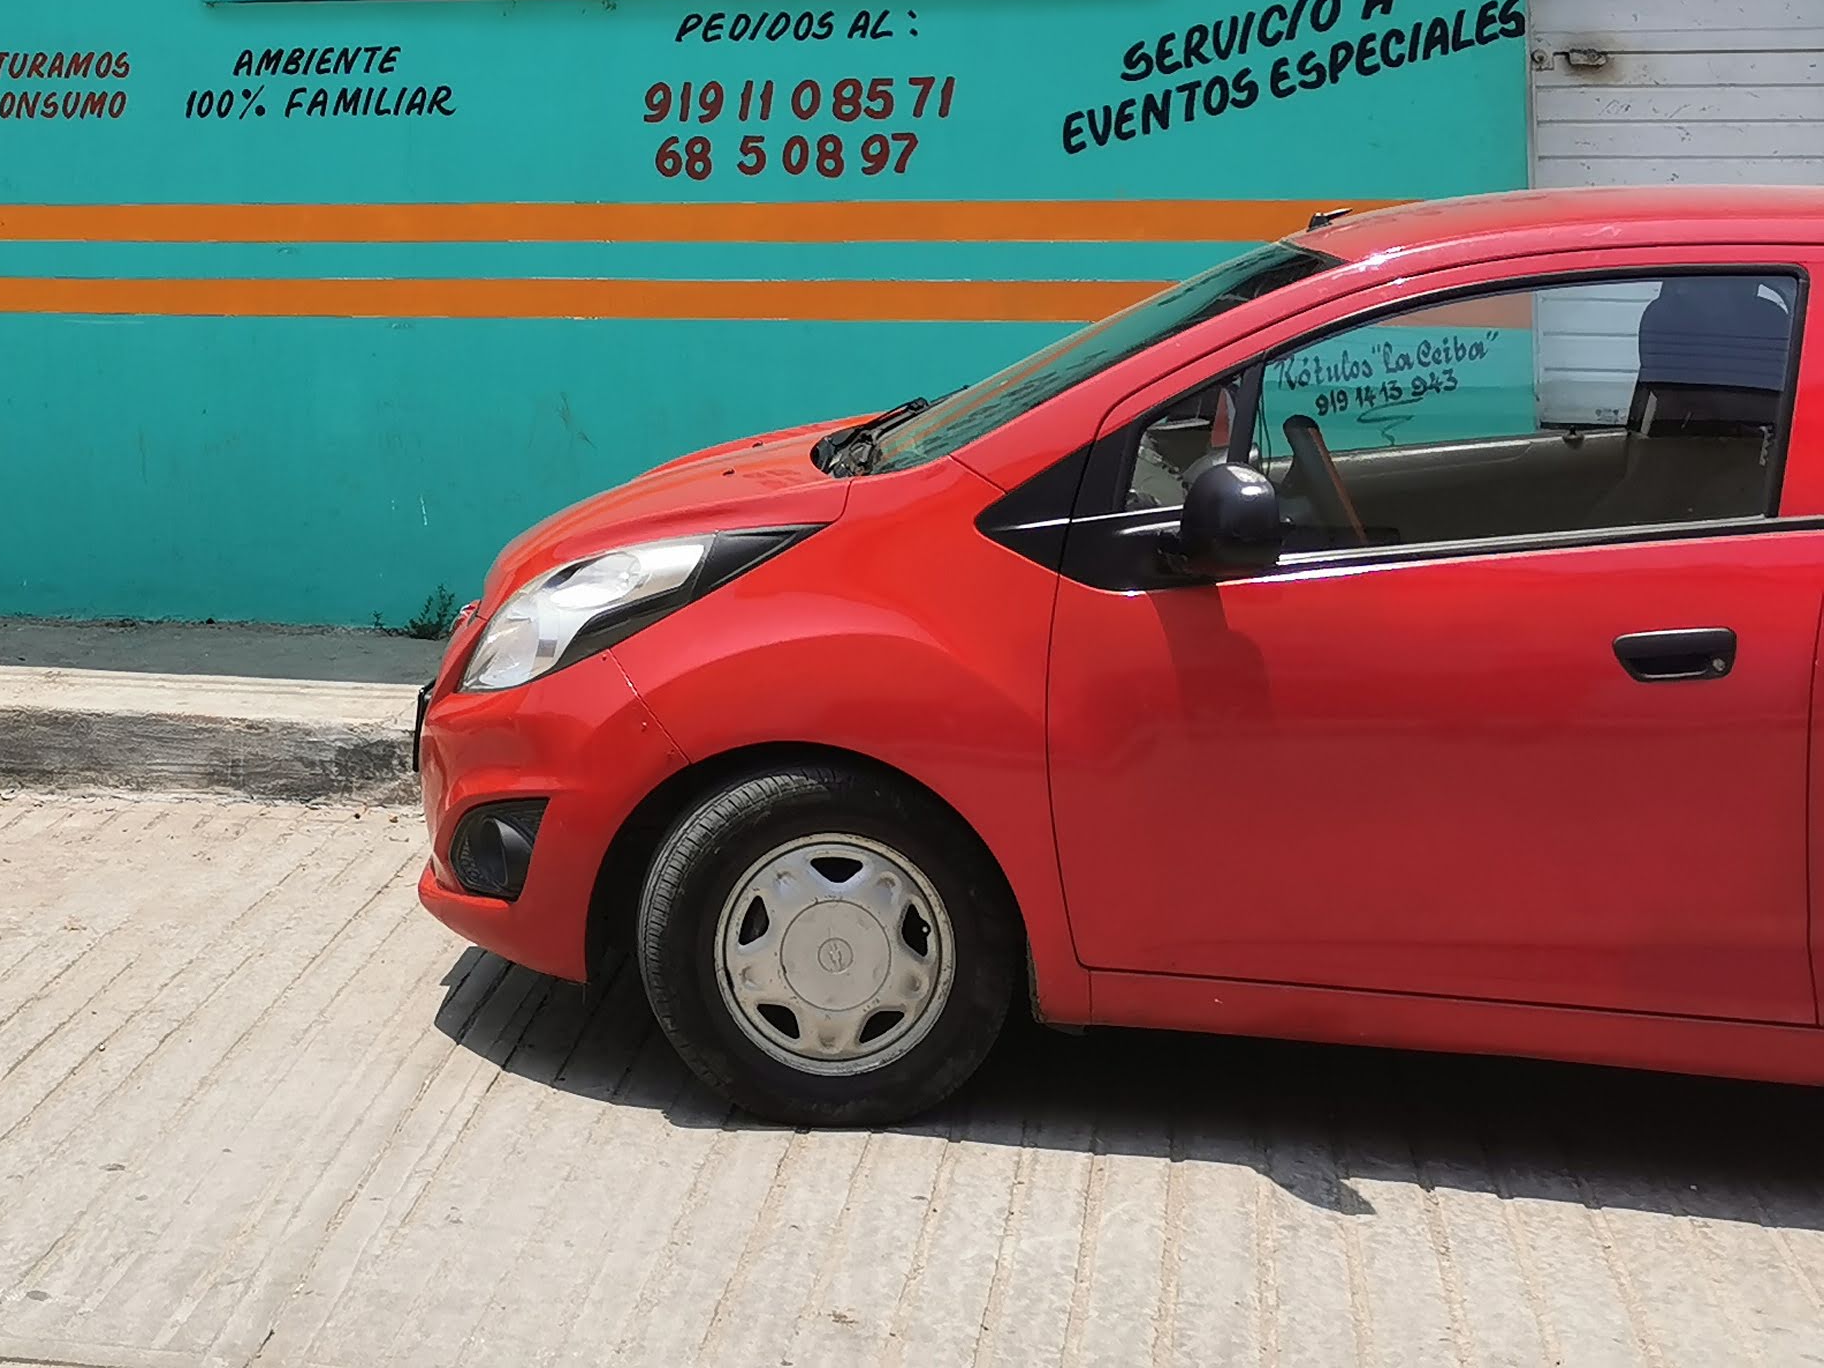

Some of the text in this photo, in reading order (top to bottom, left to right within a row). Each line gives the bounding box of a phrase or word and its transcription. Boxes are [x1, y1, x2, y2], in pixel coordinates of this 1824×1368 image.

[674, 10, 835, 43] PEDIDOS
[232, 45, 402, 77] AMBIENTE
[185, 84, 457, 120] 100% FAMILIAR
[643, 80, 725, 124] 919
[738, 79, 774, 122] 11
[1062, 66, 1260, 155] EVENTOS
[654, 135, 713, 181] 68
